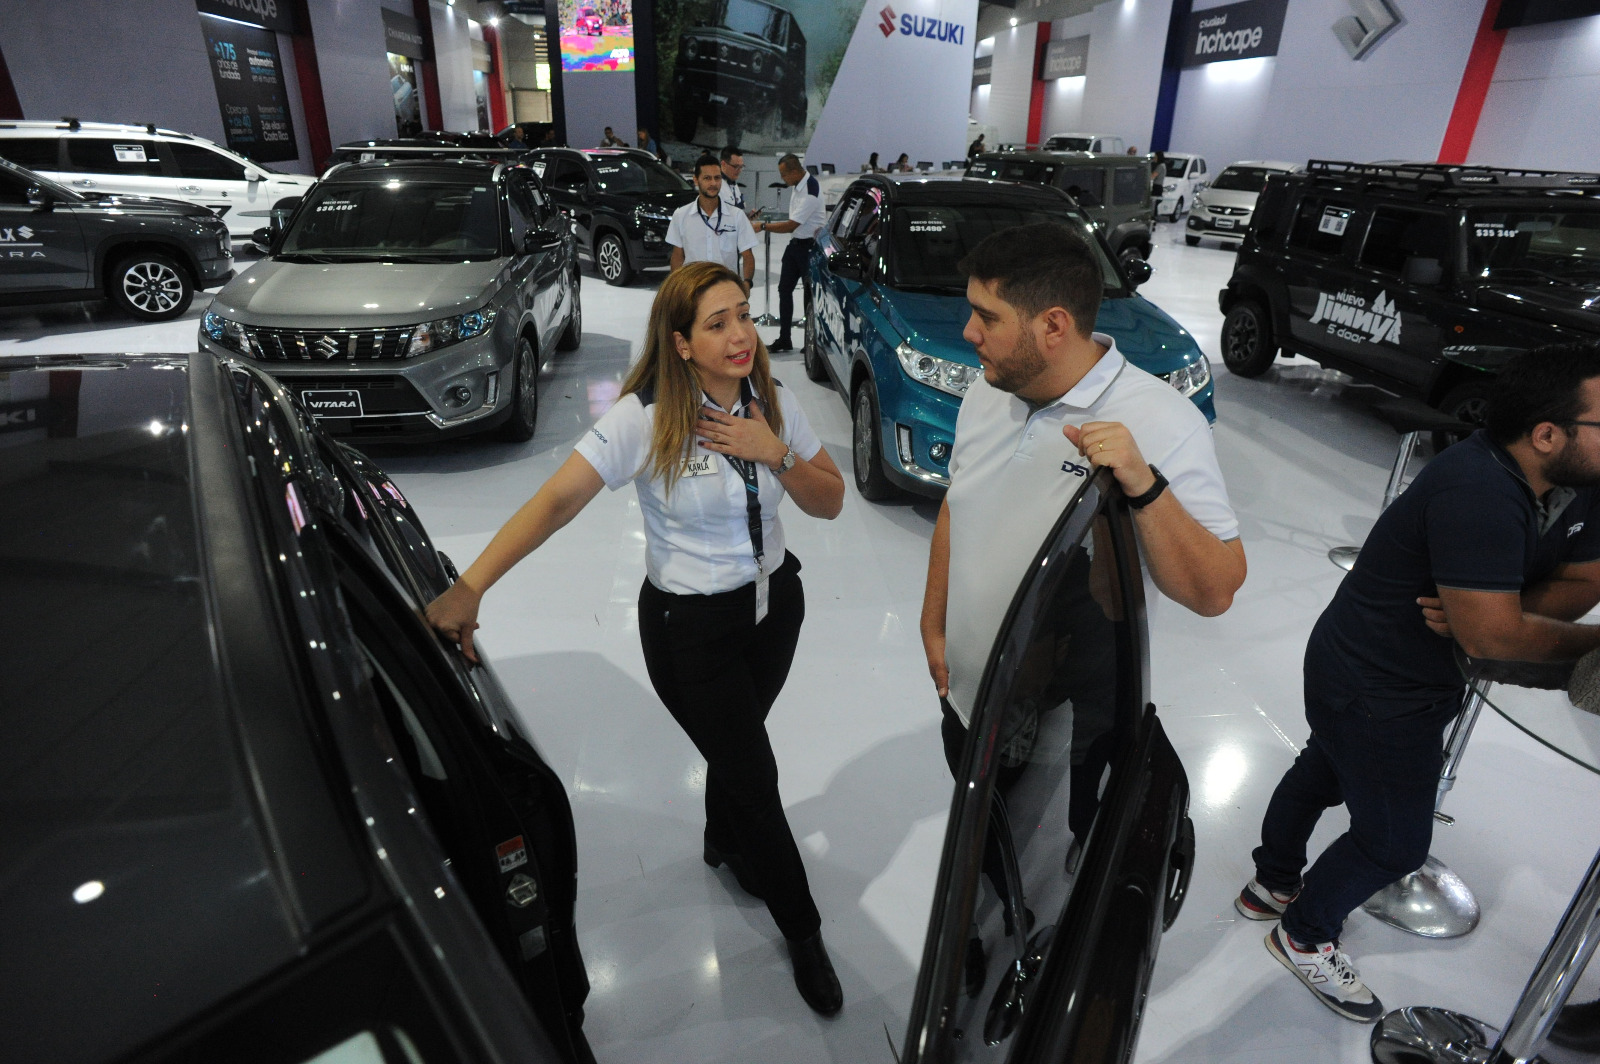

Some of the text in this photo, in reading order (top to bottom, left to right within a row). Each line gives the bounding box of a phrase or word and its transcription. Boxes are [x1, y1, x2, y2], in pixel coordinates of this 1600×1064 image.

[900, 13, 964, 45] SUZUKI
[1195, 26, 1263, 55] Inchcape
[1336, 291, 1366, 308] NUEVO
[1336, 328, 1367, 344] door
[687, 462, 710, 472] KARLA
